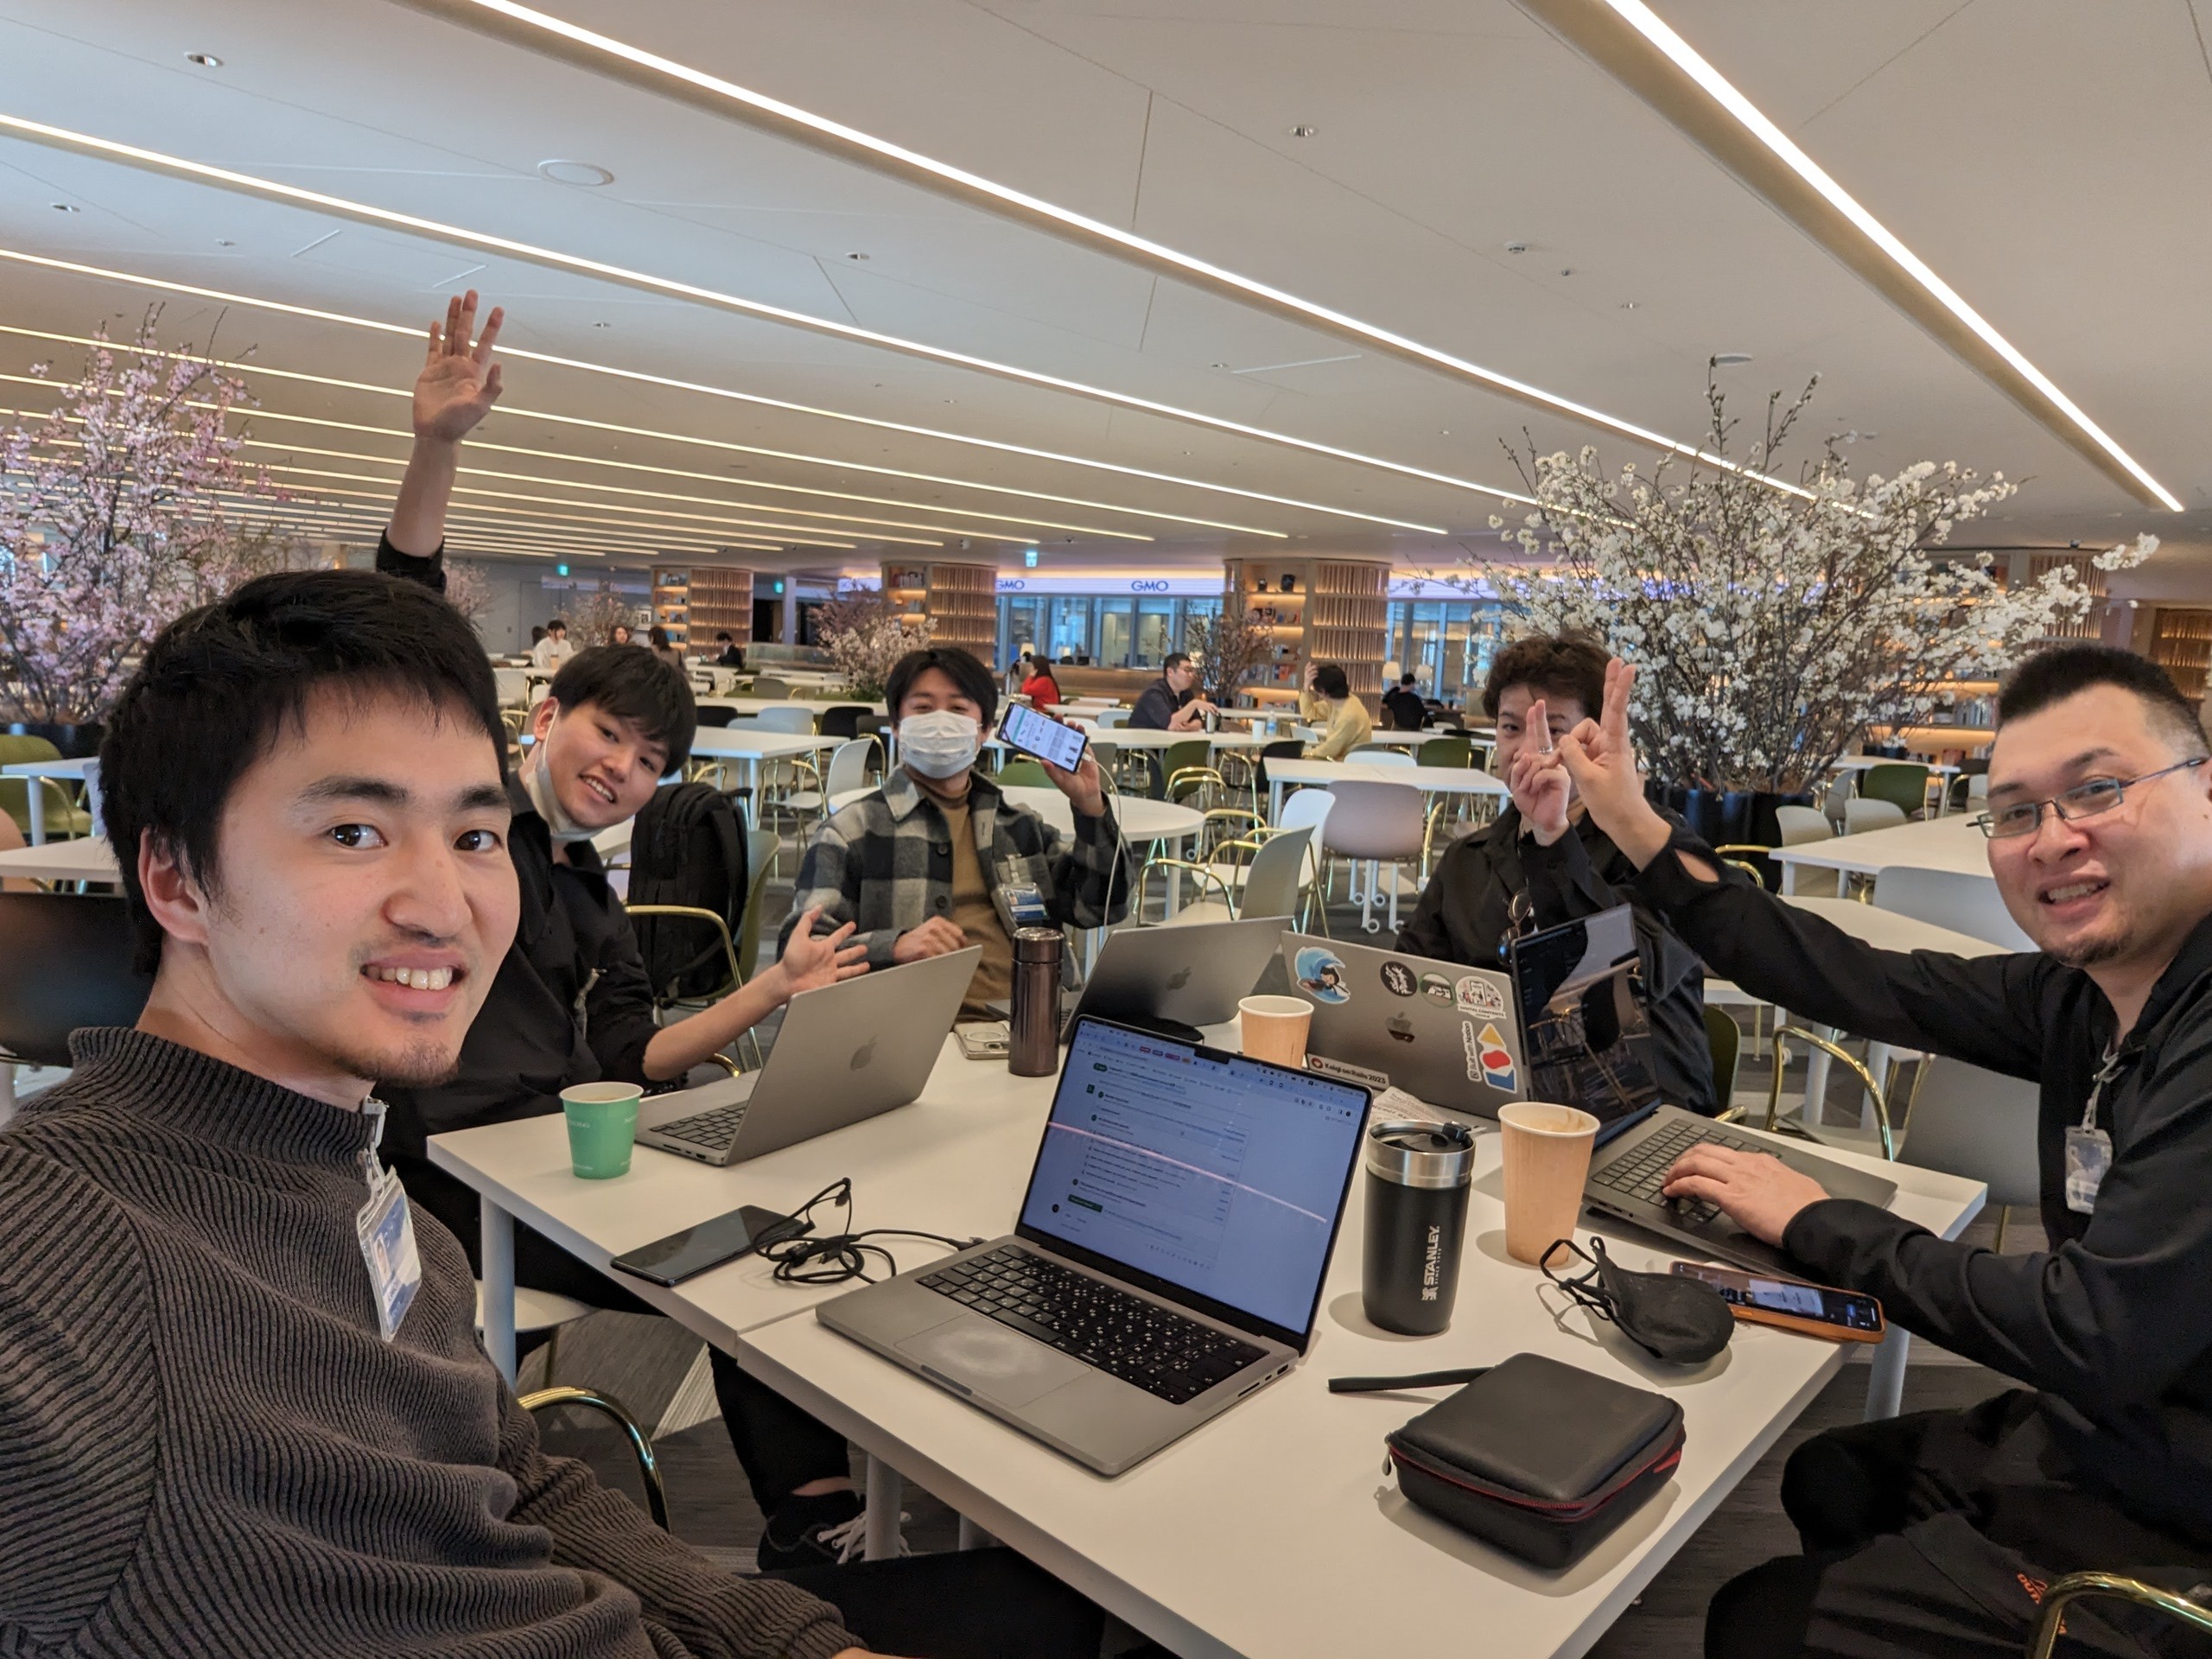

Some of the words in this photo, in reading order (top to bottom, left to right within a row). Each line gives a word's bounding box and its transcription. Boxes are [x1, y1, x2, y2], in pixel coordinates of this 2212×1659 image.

[996, 580, 1026, 591] GMO
[1131, 580, 1169, 592] GMO
[1478, 1008, 1504, 1017] CONTENTS
[1368, 1074, 1386, 1084] 2023
